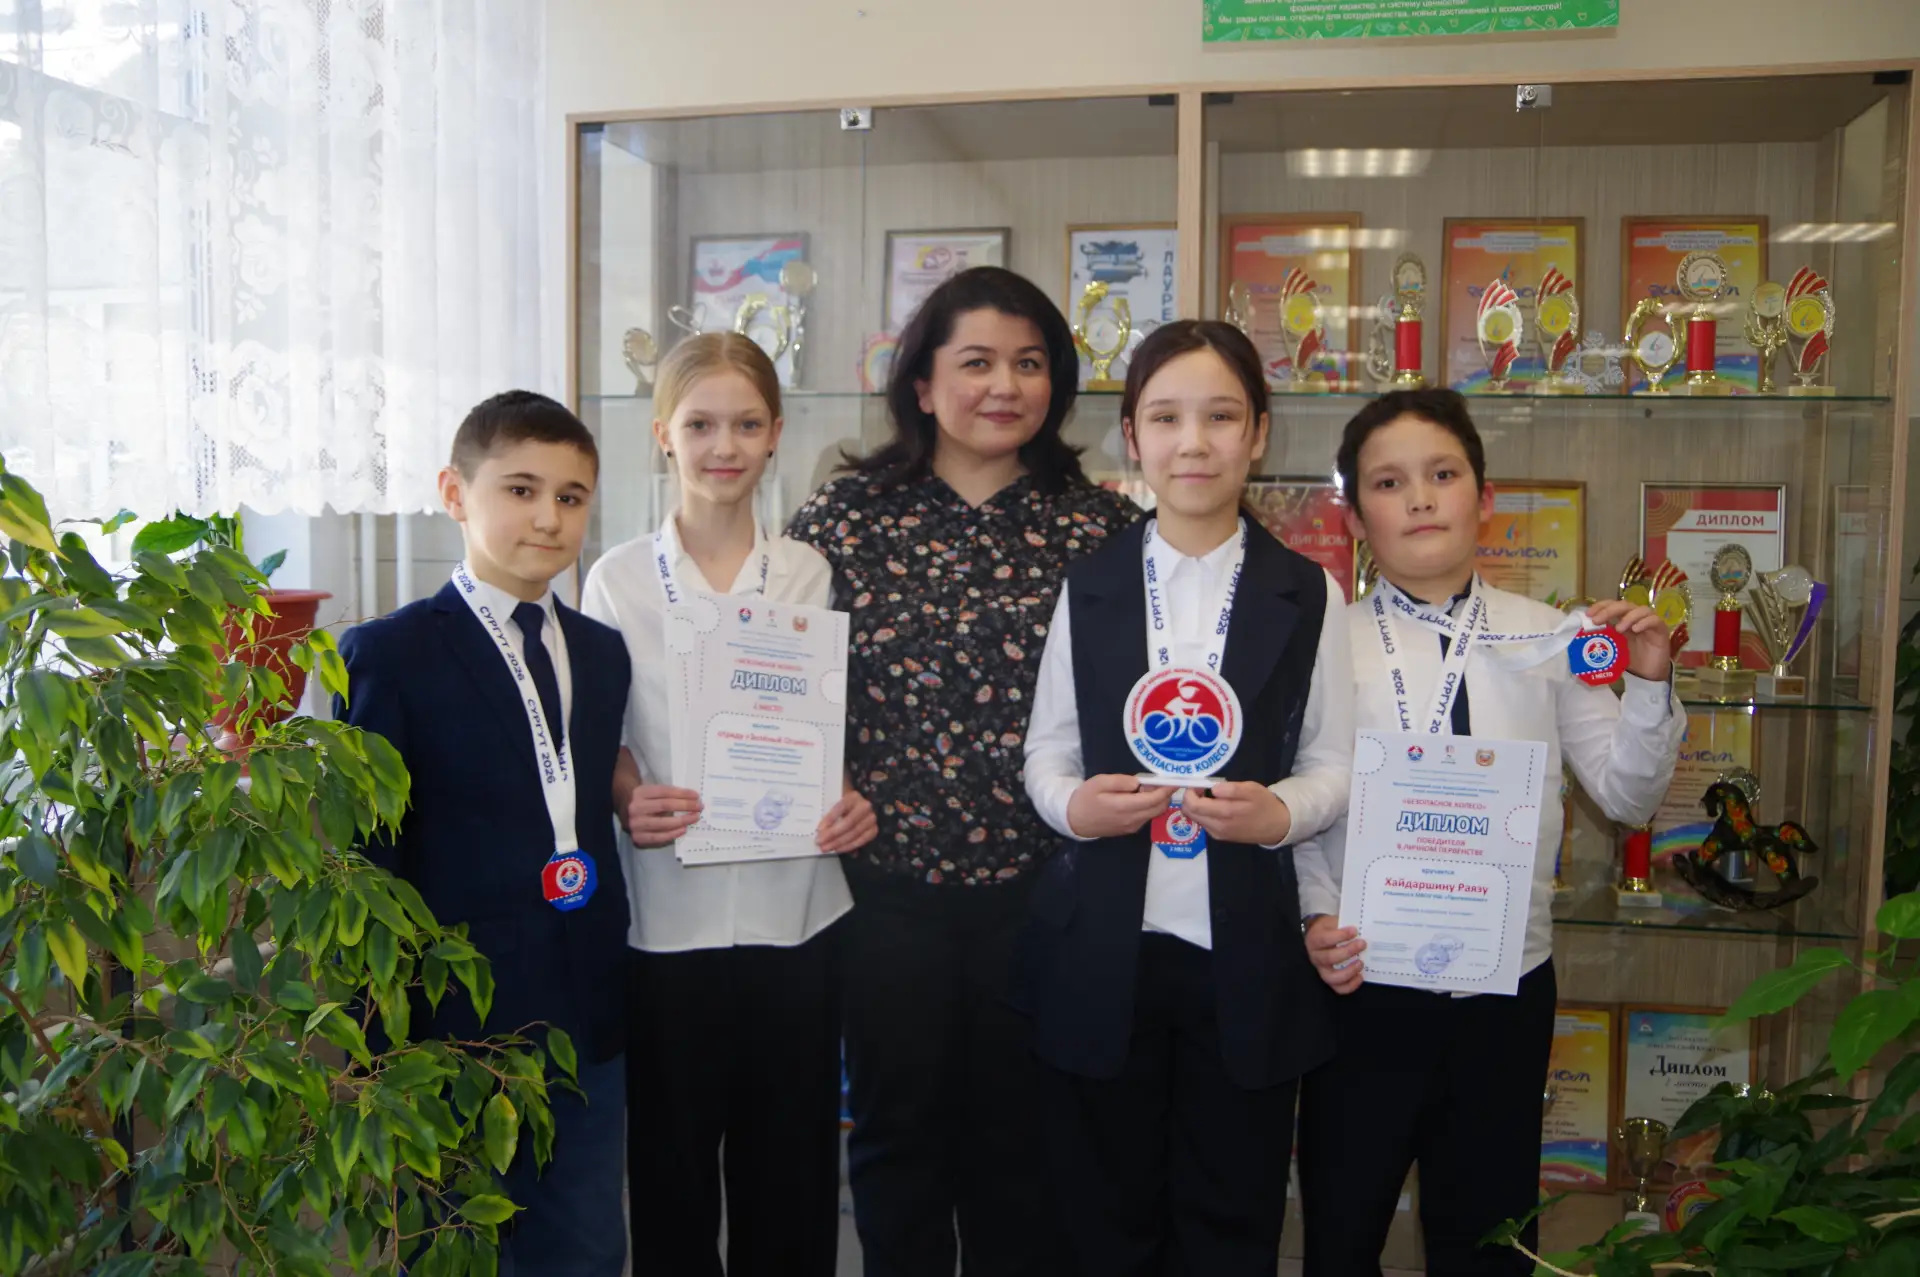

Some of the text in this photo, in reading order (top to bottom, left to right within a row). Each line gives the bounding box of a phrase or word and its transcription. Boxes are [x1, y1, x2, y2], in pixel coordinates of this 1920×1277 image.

[1218, 15, 1232, 24] Мы
[1499, 3, 1562, 13] возможностей!
[1696, 514, 1765, 526] ДИПЛОМ
[1146, 556, 1165, 630] СУРГУТ 2026
[1392, 594, 1416, 616] 2026
[1216, 607, 1231, 636] 2026
[479, 606, 526, 681] СУРГУТ 2026
[1378, 618, 1395, 655] СУРГУТ
[1454, 632, 1470, 657] 2026
[1158, 647, 1169, 666] 26
[730, 669, 807, 696] ДИПЛОМ
[1391, 668, 1411, 732] РГУТ 2026
[1430, 672, 1457, 734] СУРГУТ 20
[528, 698, 556, 785] СУРГУТ 2026
[1134, 738, 1230, 774] БЕЗОПАСНОЕ КОЛЕСО
[1396, 810, 1490, 836] ДИПЛОМ
[1404, 844, 1438, 852] ЛИЧНОМ
[1438, 846, 1484, 856] ПЕРВЕНСТВЕ
[1416, 836, 1466, 846] ПОБЕДИТЕЛЯ
[1384, 877, 1455, 892] Хайдаршину
[1458, 883, 1489, 896] Раязу
[1649, 1054, 1727, 1077] Диплом
